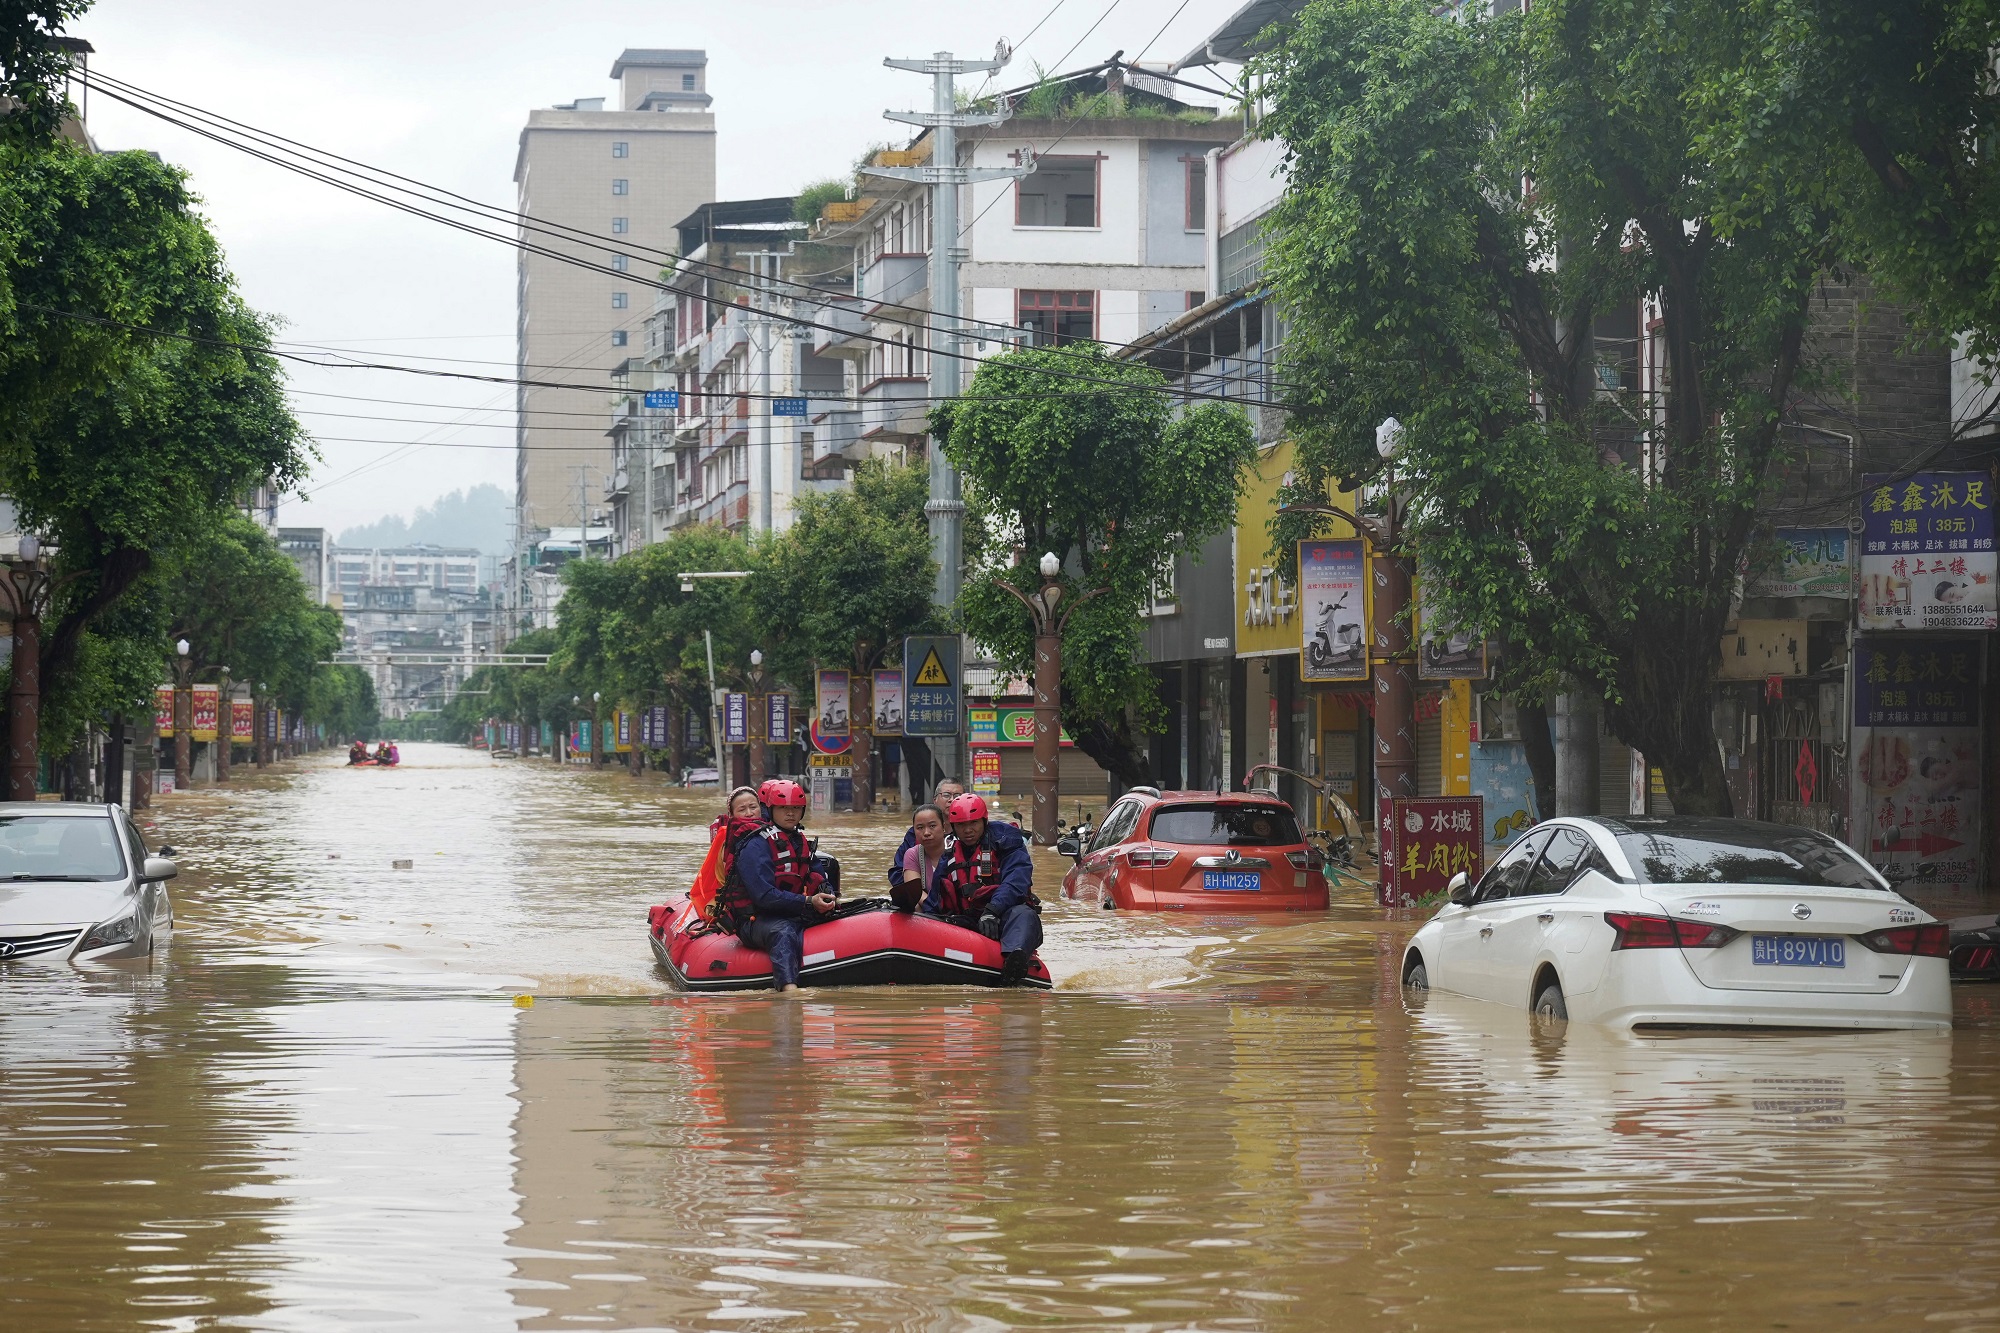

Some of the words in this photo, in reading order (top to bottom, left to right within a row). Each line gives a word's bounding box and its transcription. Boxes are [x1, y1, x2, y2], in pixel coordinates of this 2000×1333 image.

[1869, 481, 1988, 513] 鑫鑫沐足
[1890, 519, 1918, 534] 泡澡
[1868, 541, 1886, 552] 按摩
[1892, 540, 1920, 550] 木桶沐
[1925, 540, 1944, 550] 足沐
[1949, 539, 1968, 550] 拔罐
[1973, 538, 1992, 549] 刮痧
[1892, 556, 1968, 577] 请上二楼
[1876, 606, 1916, 616] 联系电话：
[1922, 605, 1984, 615] 13885551644
[1922, 617, 1984, 627] 19048336222
[1864, 650, 1969, 684] 鑫鑫沐足
[910, 692, 954, 706] 学生出入
[1880, 690, 1908, 706] 泡澡
[909, 709, 954, 722] 车辆慢行
[814, 756, 850, 765] 严管路段
[814, 768, 850, 777] 西环路
[1430, 809, 1472, 832] 水城
[1878, 804, 1960, 830] 请上二楼
[1400, 841, 1478, 880] 羊肉粉
